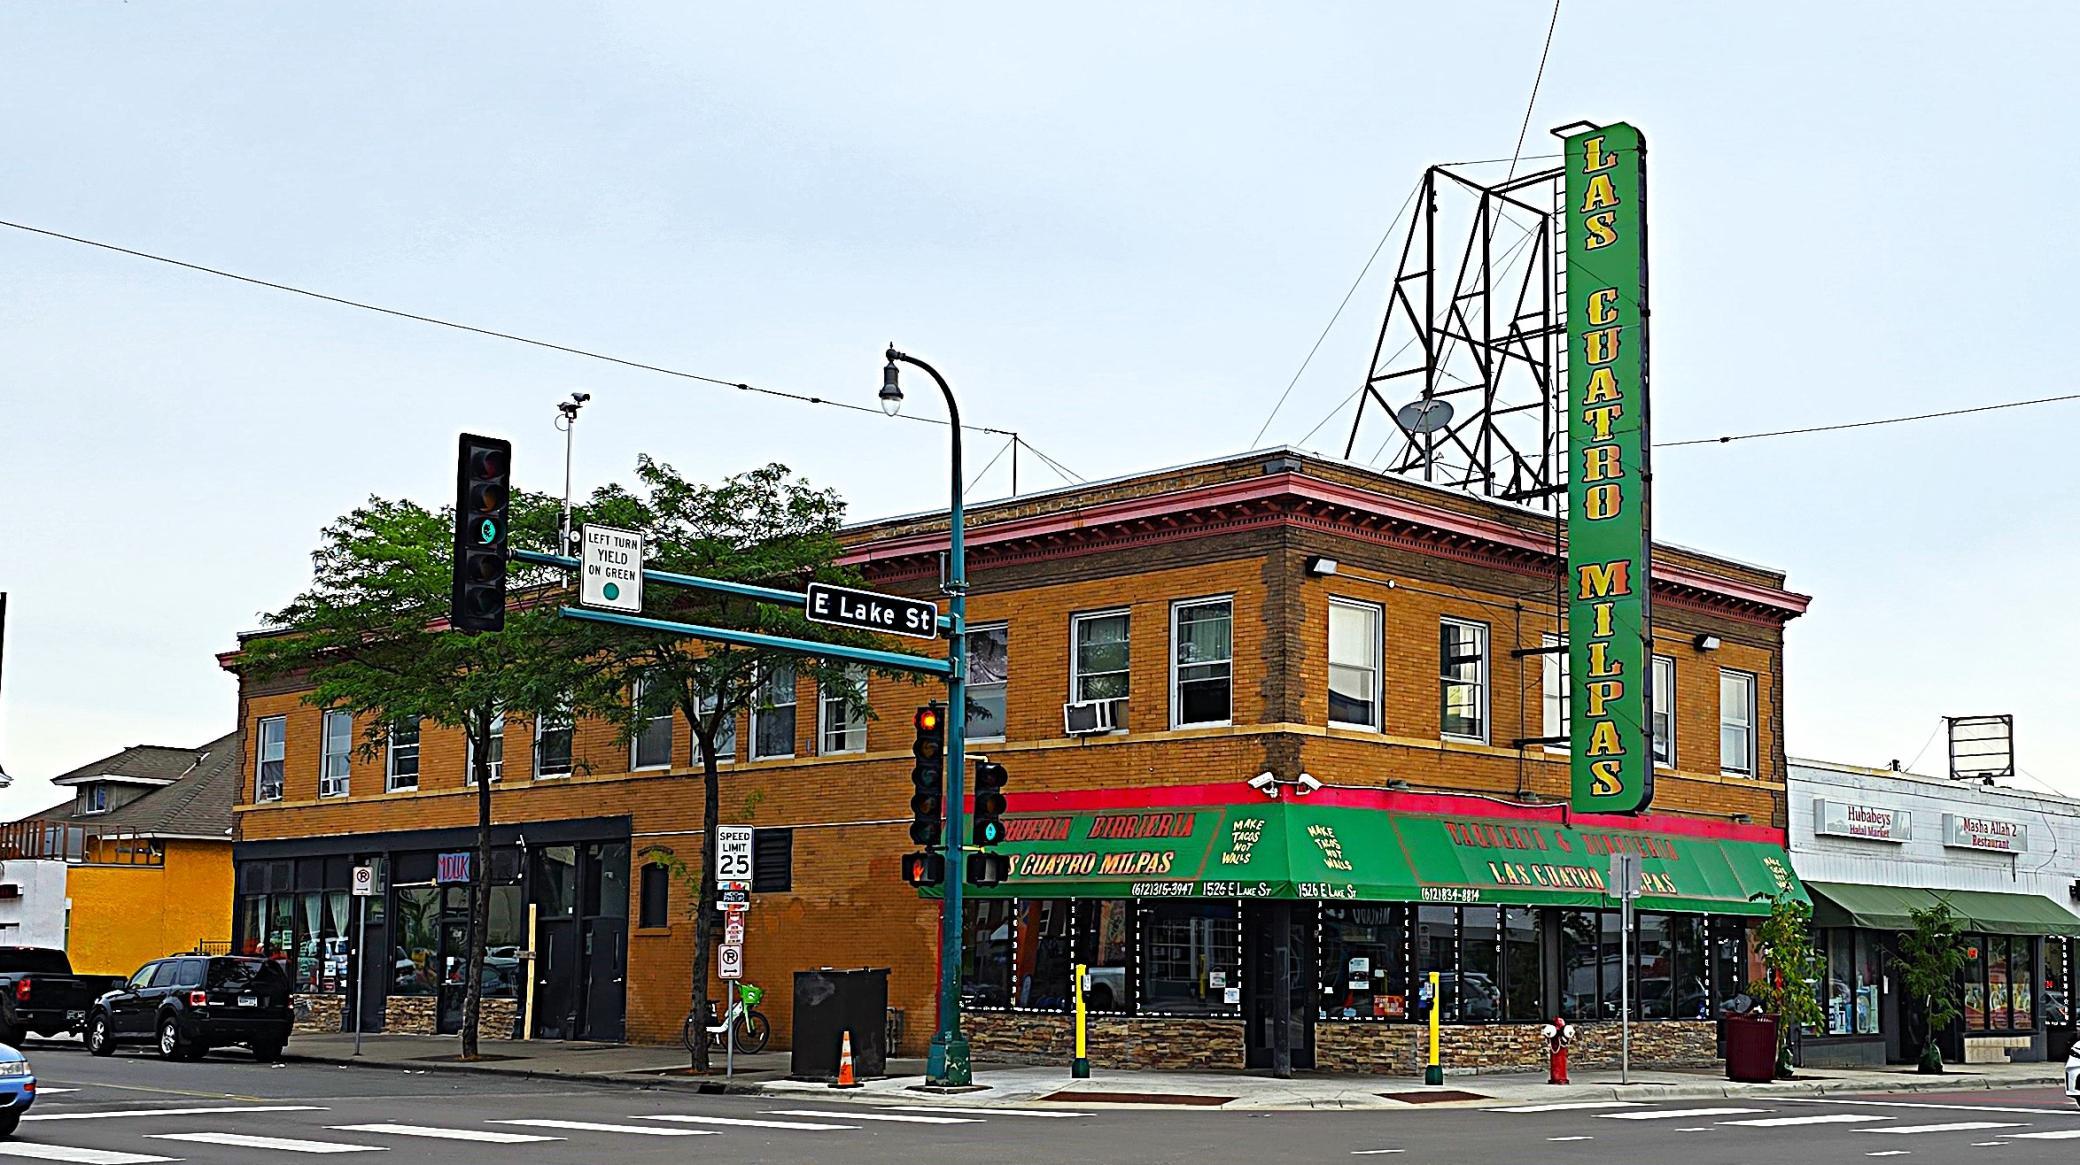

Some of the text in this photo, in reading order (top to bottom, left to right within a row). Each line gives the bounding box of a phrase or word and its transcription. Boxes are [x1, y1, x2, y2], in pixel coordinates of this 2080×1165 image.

[1577, 136, 1631, 798] LAS CUATRO MILPAS
[588, 532, 638, 550] LEFT TURN
[597, 548, 628, 565] YIELD
[588, 564, 636, 581] ON GREEN
[815, 592, 930, 630] E Lake St
[1847, 805, 1891, 826] Hubabeys
[1233, 818, 1265, 831] MAKE
[1307, 825, 1335, 838] MAKE
[1850, 824, 1889, 839] Halal Market
[1963, 817, 2017, 837] Masha Allah 2
[719, 832, 750, 841] SPEED
[1232, 831, 1261, 843] TACOS
[1972, 834, 2010, 850] Restaurant
[722, 843, 747, 852] LIMIT
[1233, 842, 1253, 852] NOT
[1314, 838, 1341, 850] TACOS
[1222, 852, 1251, 865] WALLS
[1325, 849, 1342, 859] NOT
[719, 854, 749, 875] 25
[1020, 852, 1096, 876] CUATRO
[1097, 851, 1174, 876] MILPAS
[1324, 858, 1353, 871] WALLS
[1487, 860, 1532, 885] LAS
[1530, 863, 1605, 890] CUATRO
[1131, 882, 1194, 896] (612)315-3947
[1202, 882, 1227, 896] 1526
[1228, 883, 1235, 896] E
[1298, 883, 1319, 897] 1526
[1320, 884, 1327, 897] E
